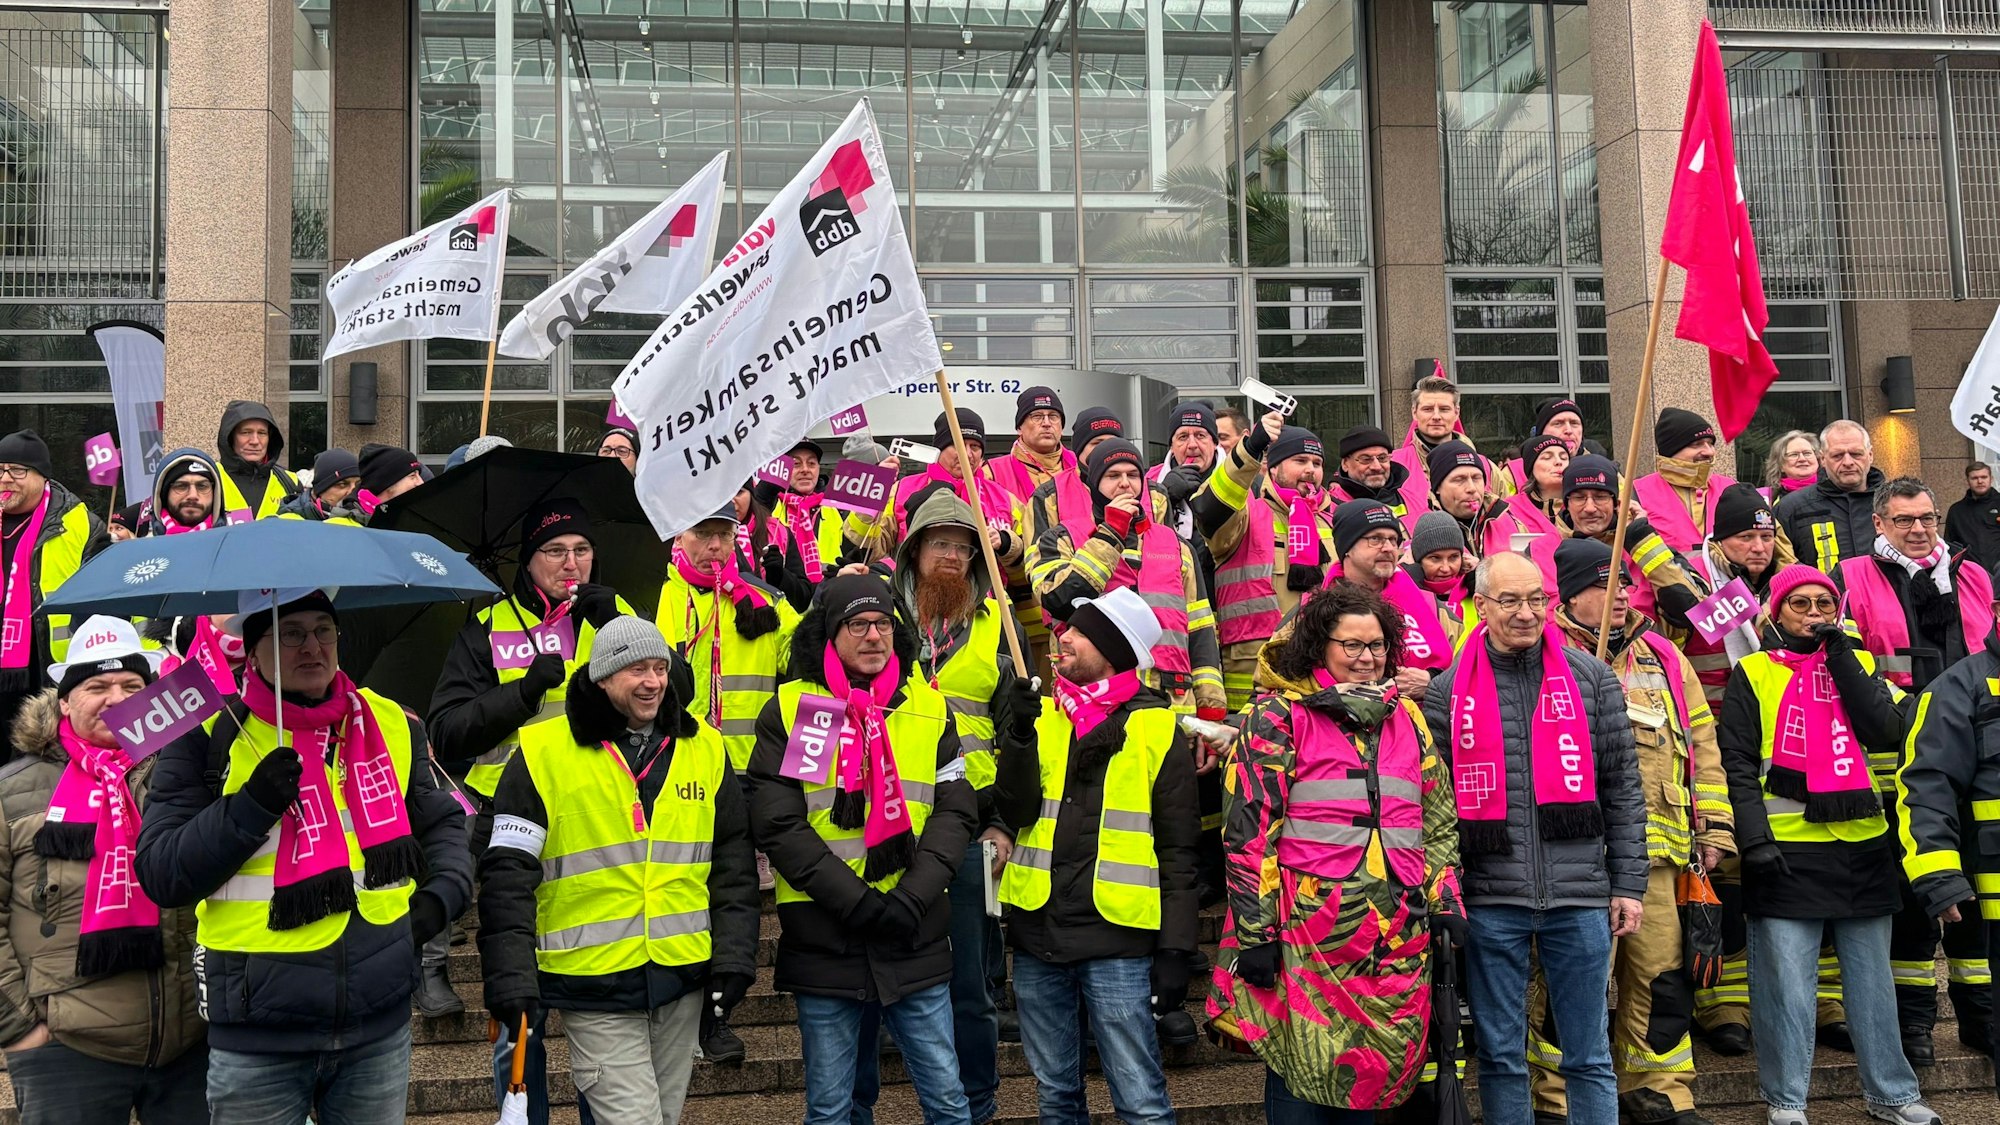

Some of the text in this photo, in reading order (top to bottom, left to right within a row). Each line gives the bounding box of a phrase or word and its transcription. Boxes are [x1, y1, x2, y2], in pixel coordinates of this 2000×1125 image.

[966, 379, 995, 393] Str.
[1000, 379, 1021, 394] 62
[832, 411, 861, 430] vdla
[833, 472, 885, 501] vdla
[1698, 592, 1749, 634] vdla
[85, 630, 118, 650] dbb
[496, 632, 562, 660] vdla
[118, 684, 206, 746] vdla
[798, 709, 834, 775] vdla
[1558, 733, 1582, 793] dbb
